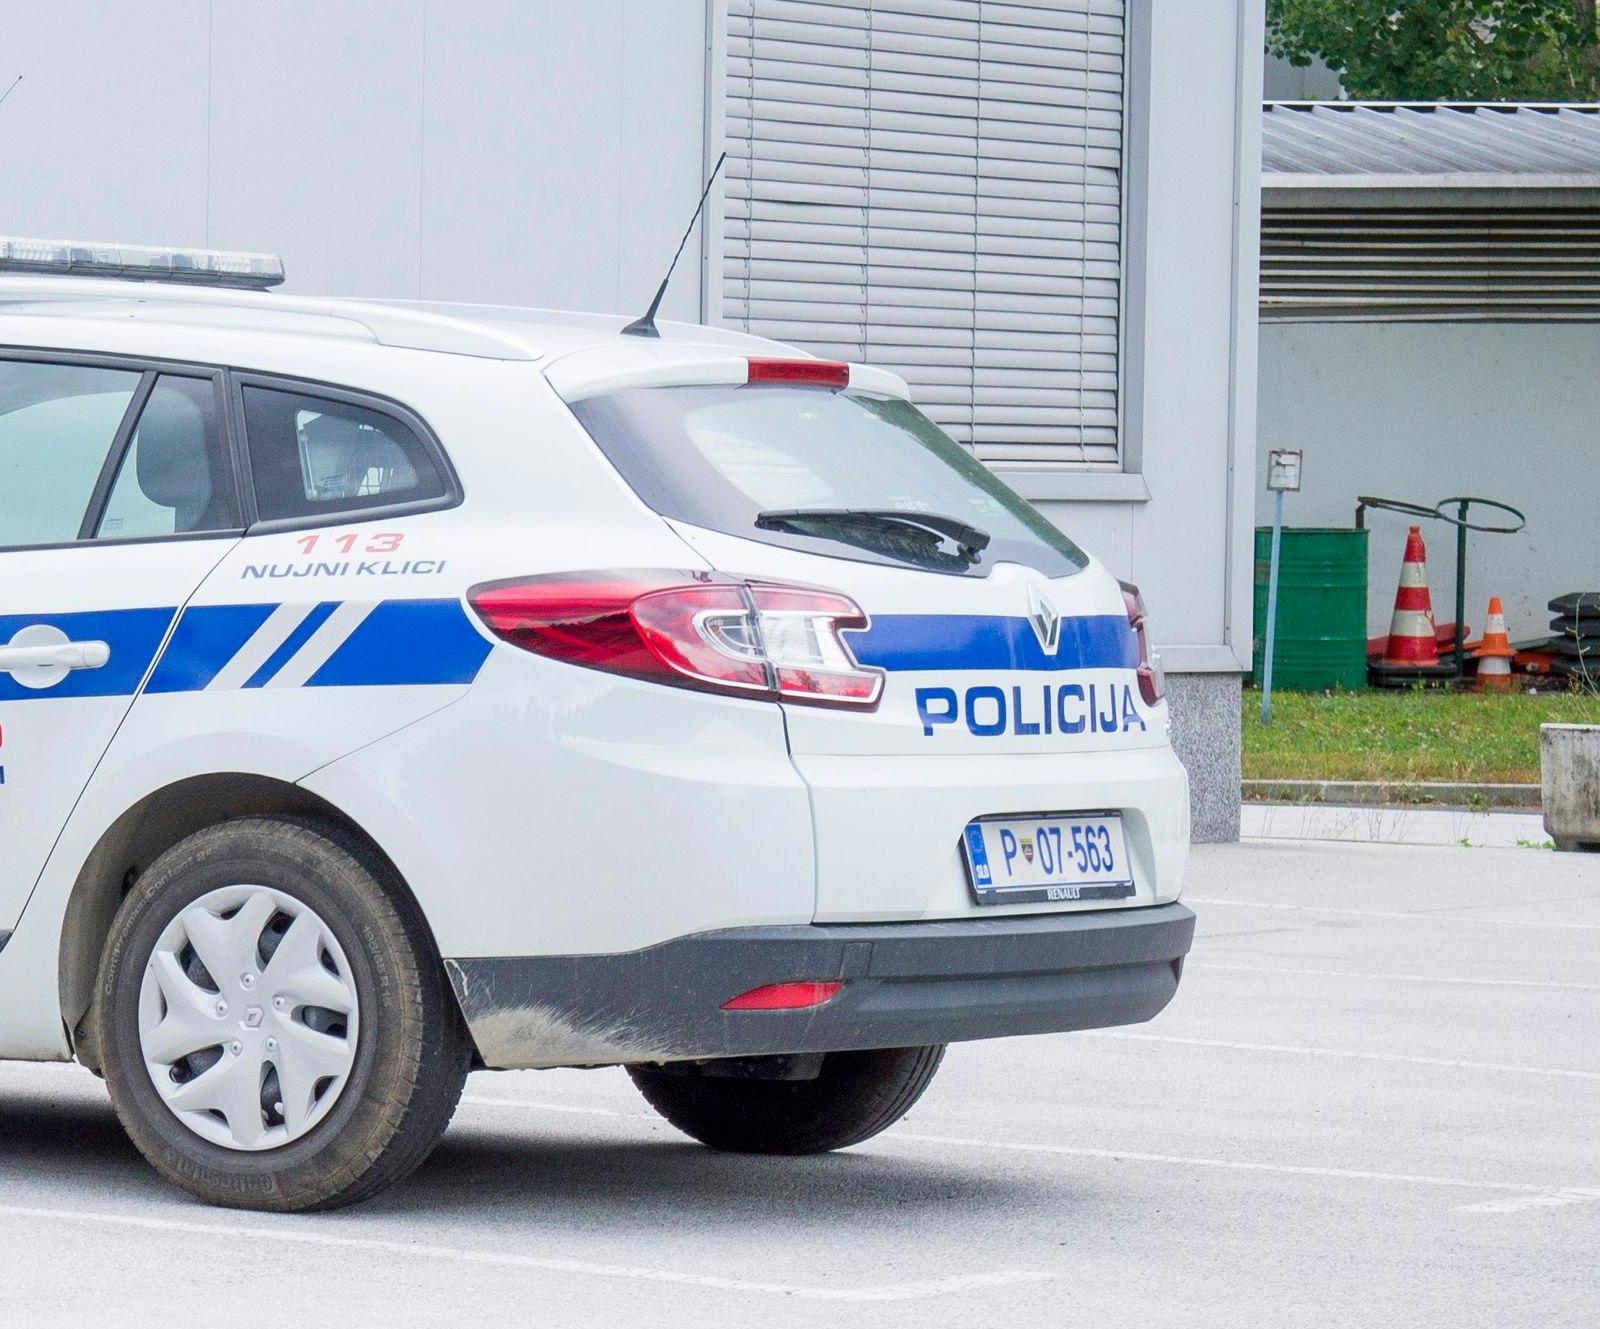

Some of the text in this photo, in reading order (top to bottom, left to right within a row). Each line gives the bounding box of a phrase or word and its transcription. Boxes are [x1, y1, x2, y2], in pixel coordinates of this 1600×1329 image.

[296, 533, 405, 555] 113
[241, 559, 447, 580] NUJNI KLICI
[914, 683, 1147, 737] POLICIJA
[1000, 824, 1114, 877] P 07-563
[975, 864, 990, 880] SLO
[1047, 887, 1081, 901] RENAULT
